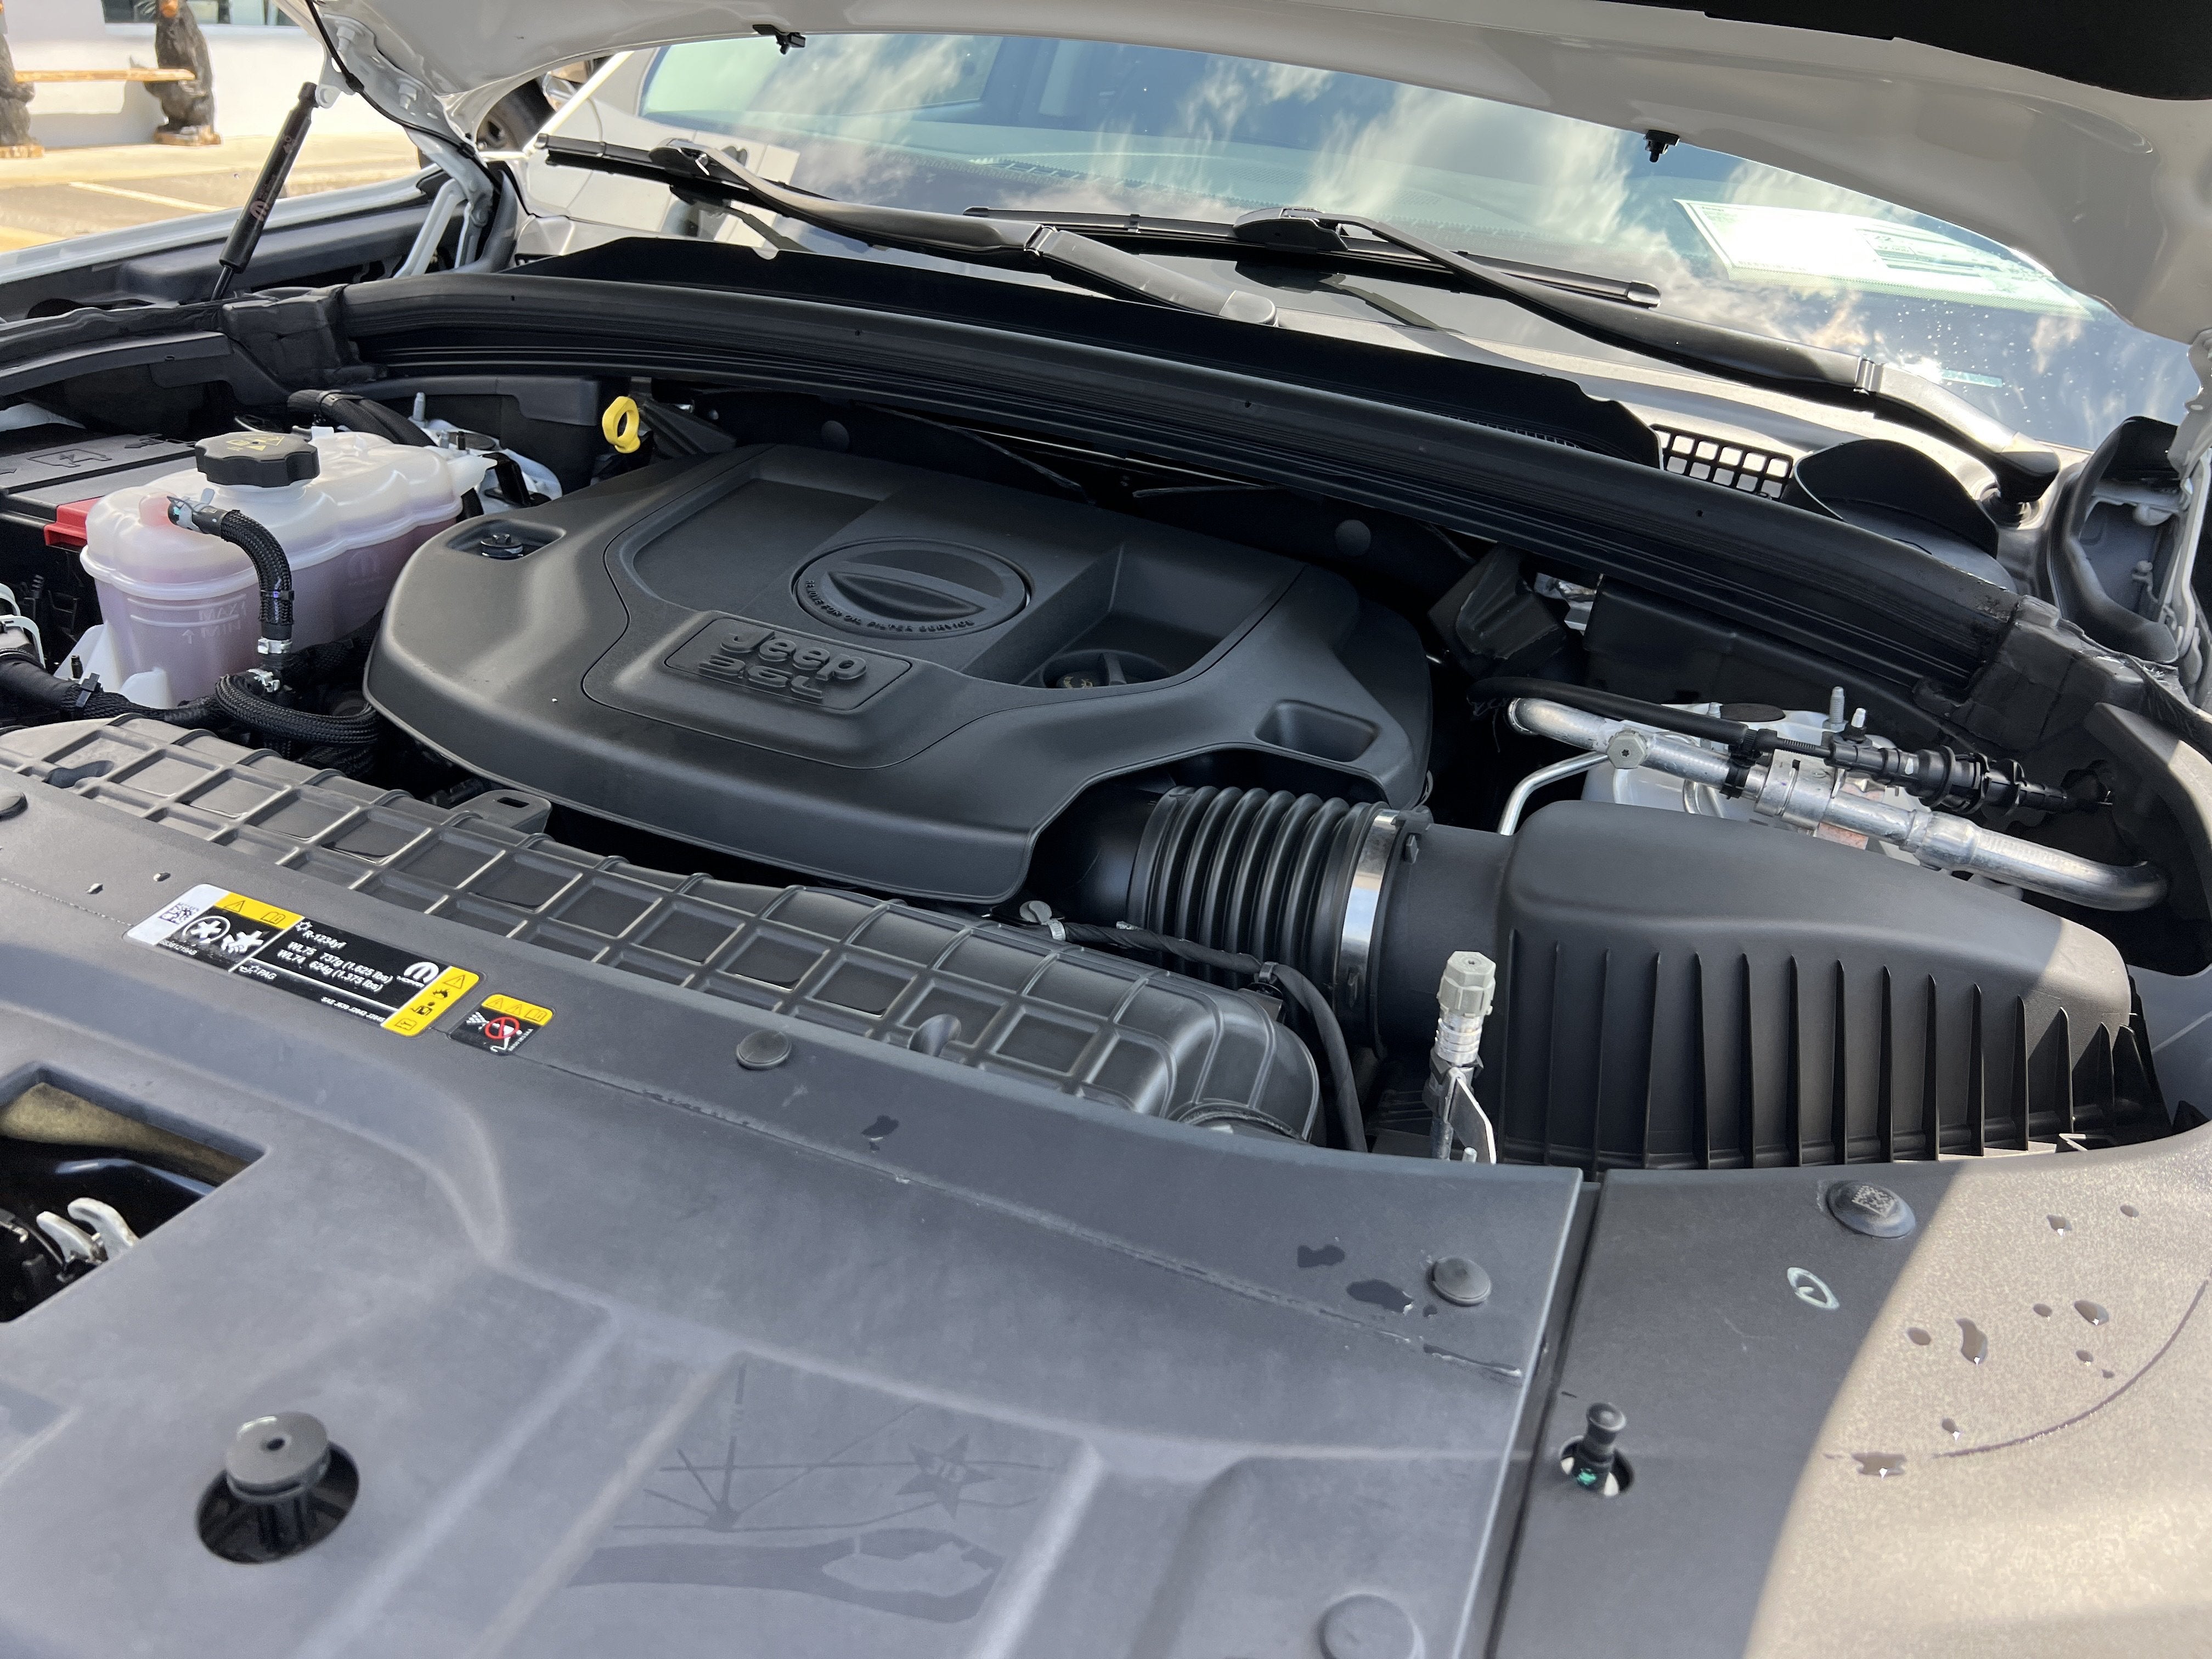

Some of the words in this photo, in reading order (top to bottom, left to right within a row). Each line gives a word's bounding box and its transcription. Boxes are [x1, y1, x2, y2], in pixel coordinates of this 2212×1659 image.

[821, 603, 842, 617] FOR
[843, 614, 862, 625] OIL
[698, 653, 823, 699] 3.6L
[720, 631, 867, 681] Jeep
[303, 930, 347, 949] R-1234yf
[256, 969, 277, 980] PAG
[277, 949, 306, 964] WL74
[309, 961, 334, 976] 624g
[362, 979, 383, 992] lbs)
[287, 941, 317, 956] WL75
[319, 952, 344, 967] 737g
[342, 961, 375, 976] (1.625
[372, 970, 393, 984] lbs)
